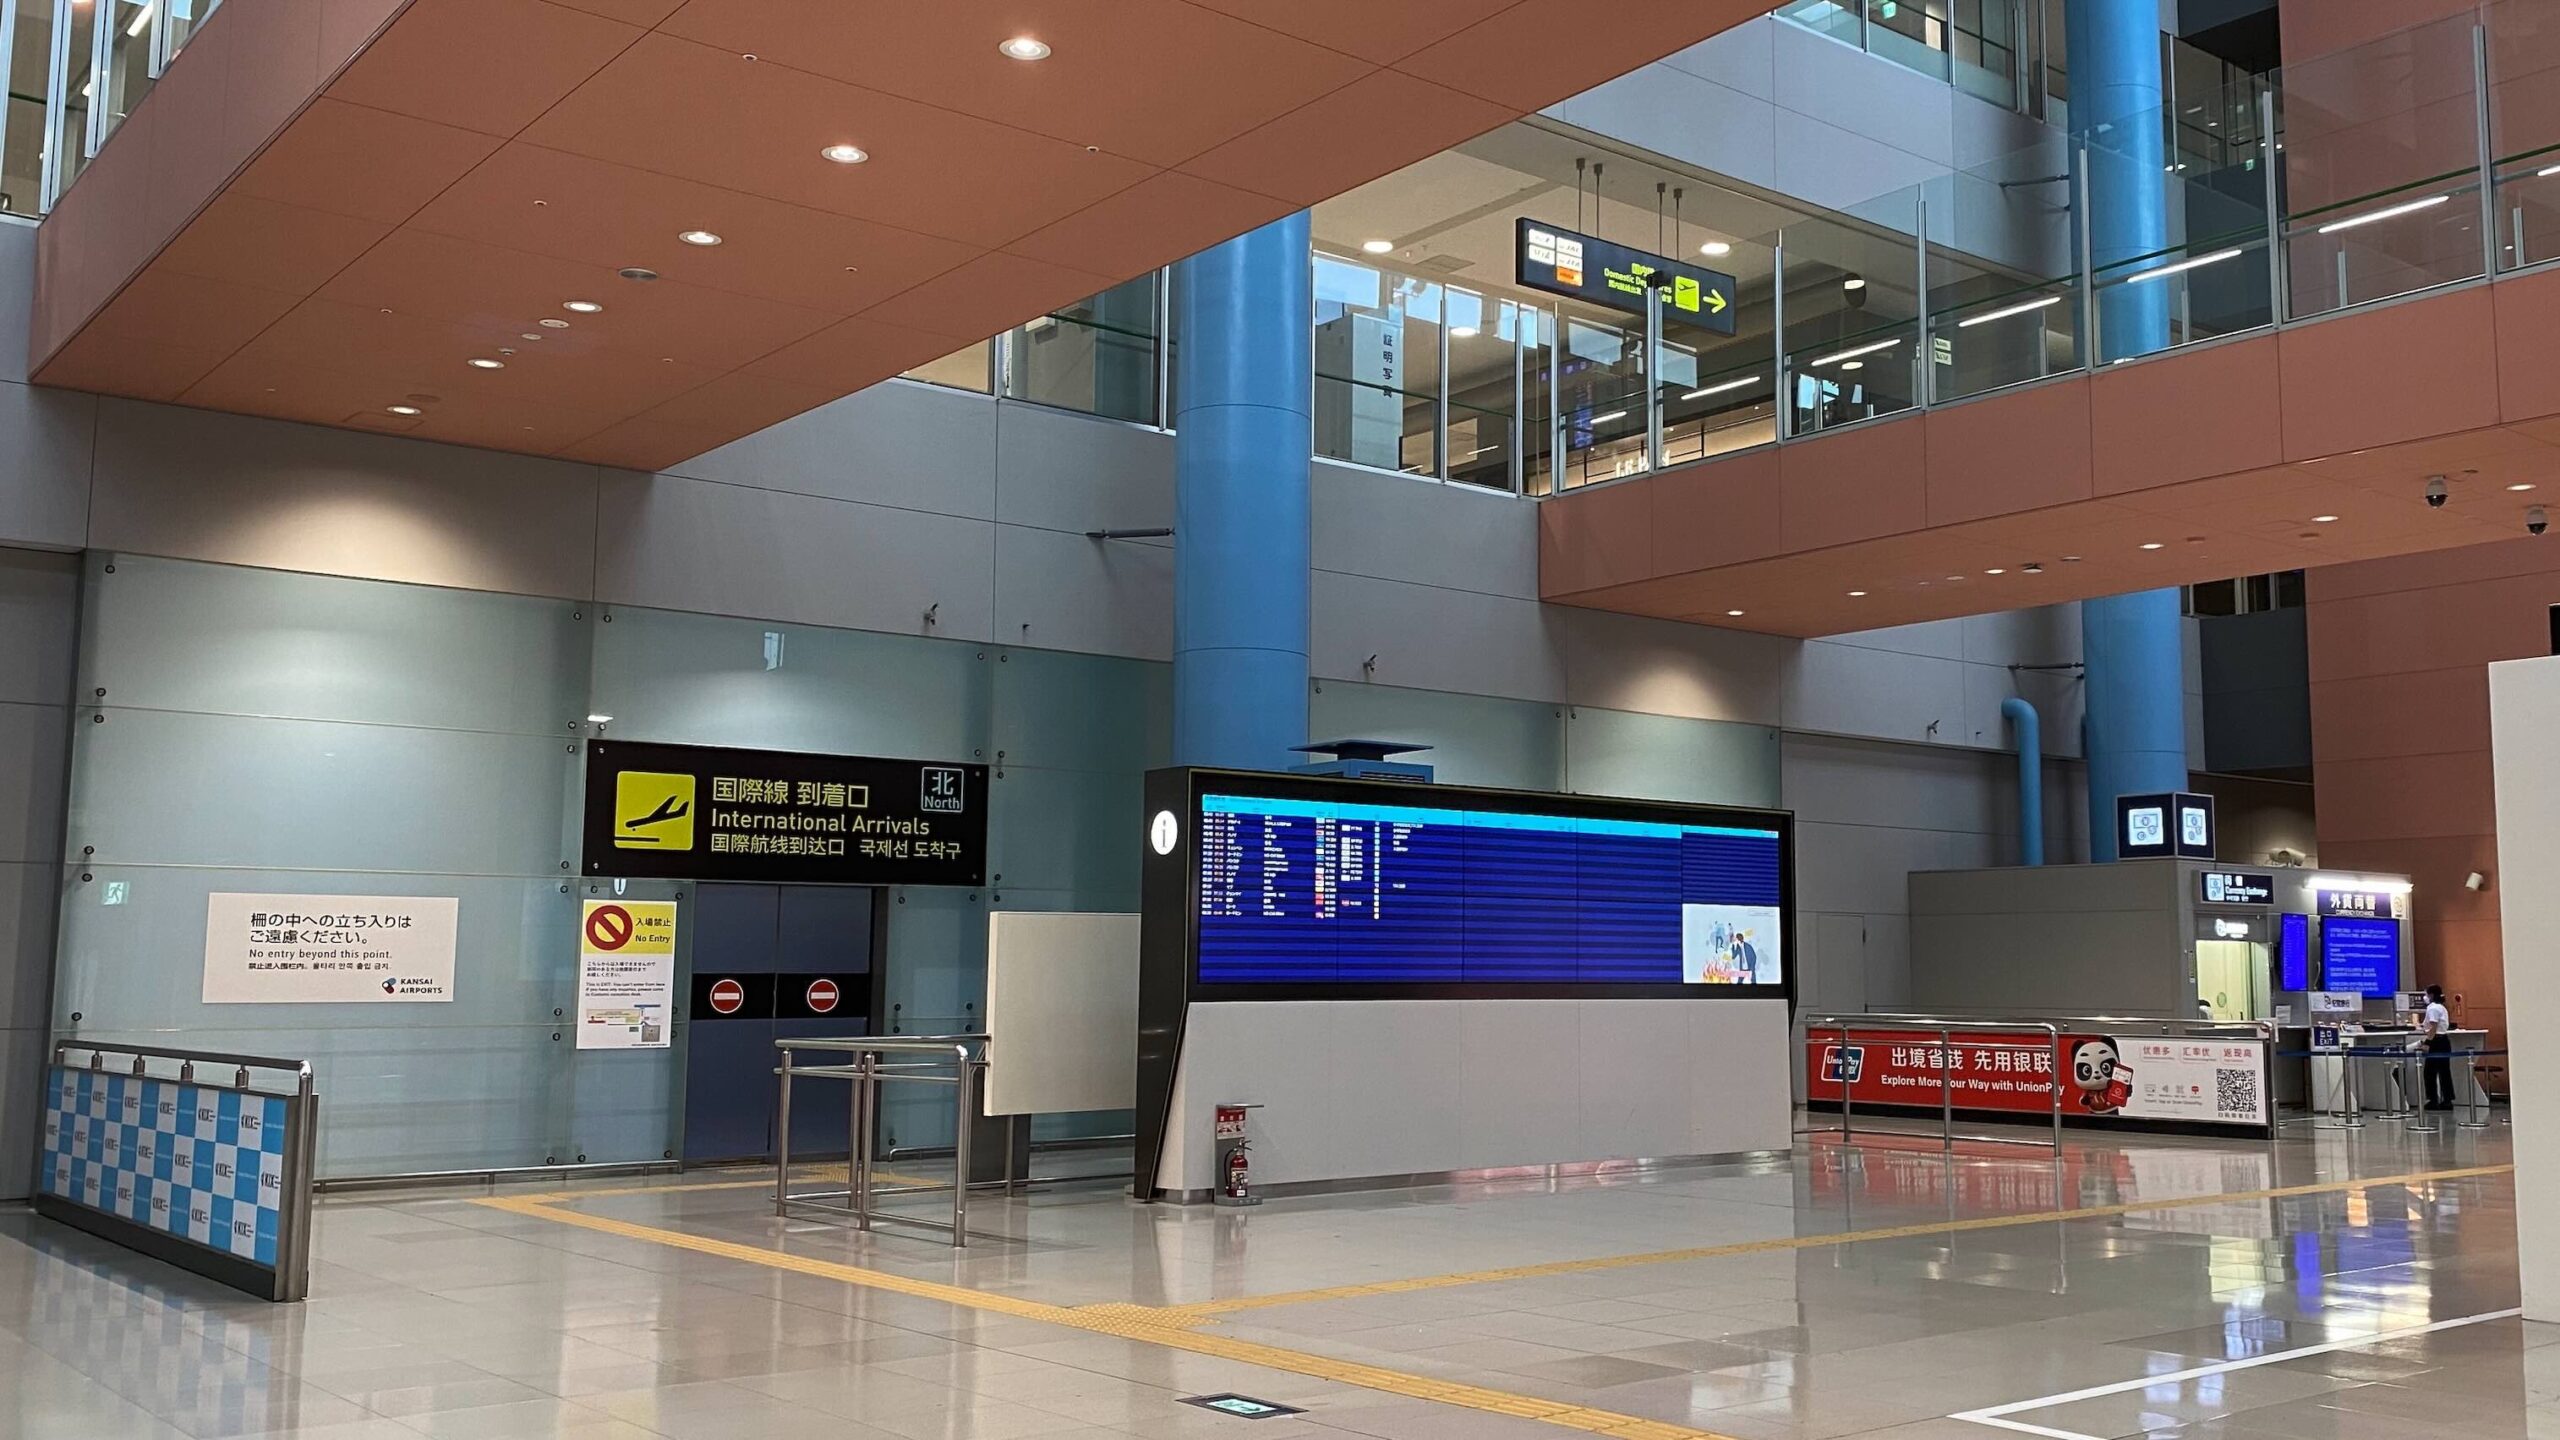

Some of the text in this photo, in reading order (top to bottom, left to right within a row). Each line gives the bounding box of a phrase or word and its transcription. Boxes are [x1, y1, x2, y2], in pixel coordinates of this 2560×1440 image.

[1604, 267, 1634, 284] Domestic
[931, 771, 955, 796] 北
[712, 777, 869, 808] 国際線 到着口
[924, 795, 961, 810] North
[711, 808, 931, 836] International Arrivals
[859, 838, 962, 861] 국제선 도착구
[250, 913, 412, 929] 柵の中への立ち入りは
[635, 917, 671, 927] 入場禁止
[250, 929, 369, 945] ご遠慮ください。
[635, 934, 671, 944] No Entry
[249, 949, 393, 961] No entry beyond this point.
[400, 978, 433, 986] KANSAI
[2319, 1037, 2333, 1045] EXIT
[1827, 1055, 1859, 1067] UnioPay
[1881, 1074, 2065, 1096] Explore More our Way with UnionPy
